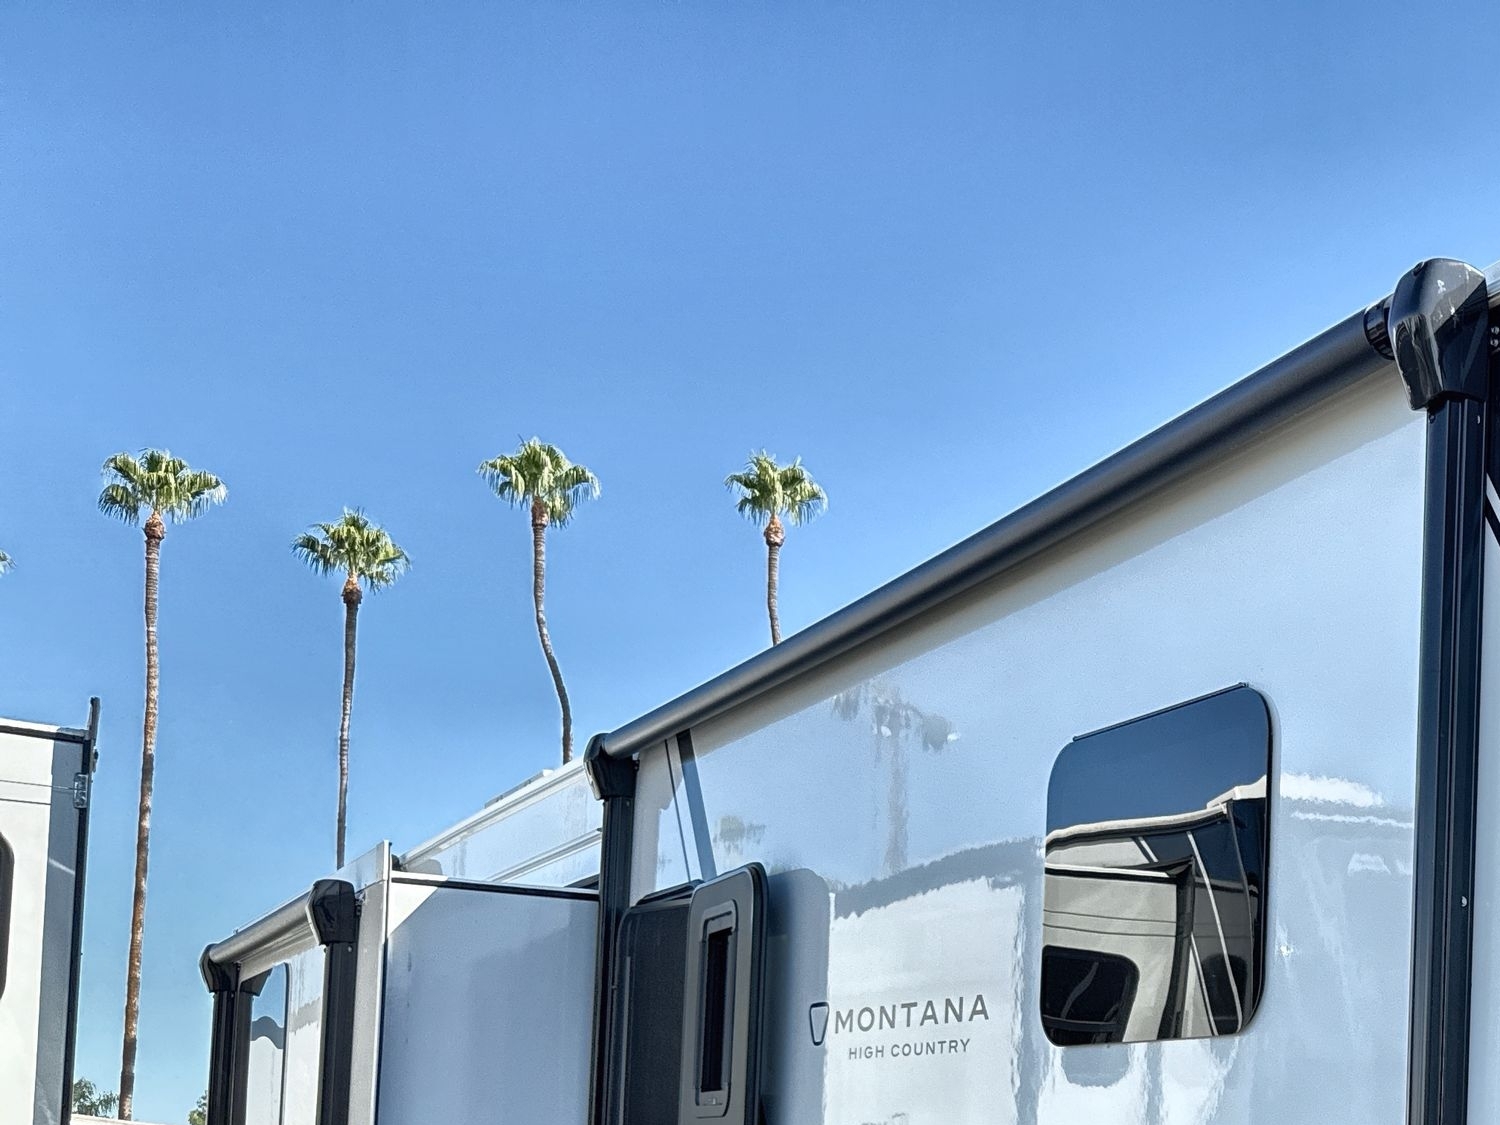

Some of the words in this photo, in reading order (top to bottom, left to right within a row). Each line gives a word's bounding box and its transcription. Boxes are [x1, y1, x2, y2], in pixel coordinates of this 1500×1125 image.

[834, 994, 989, 1034] MONTANA
[849, 1045, 885, 1060] HIGH
[891, 1038, 970, 1058] COUNTRY
